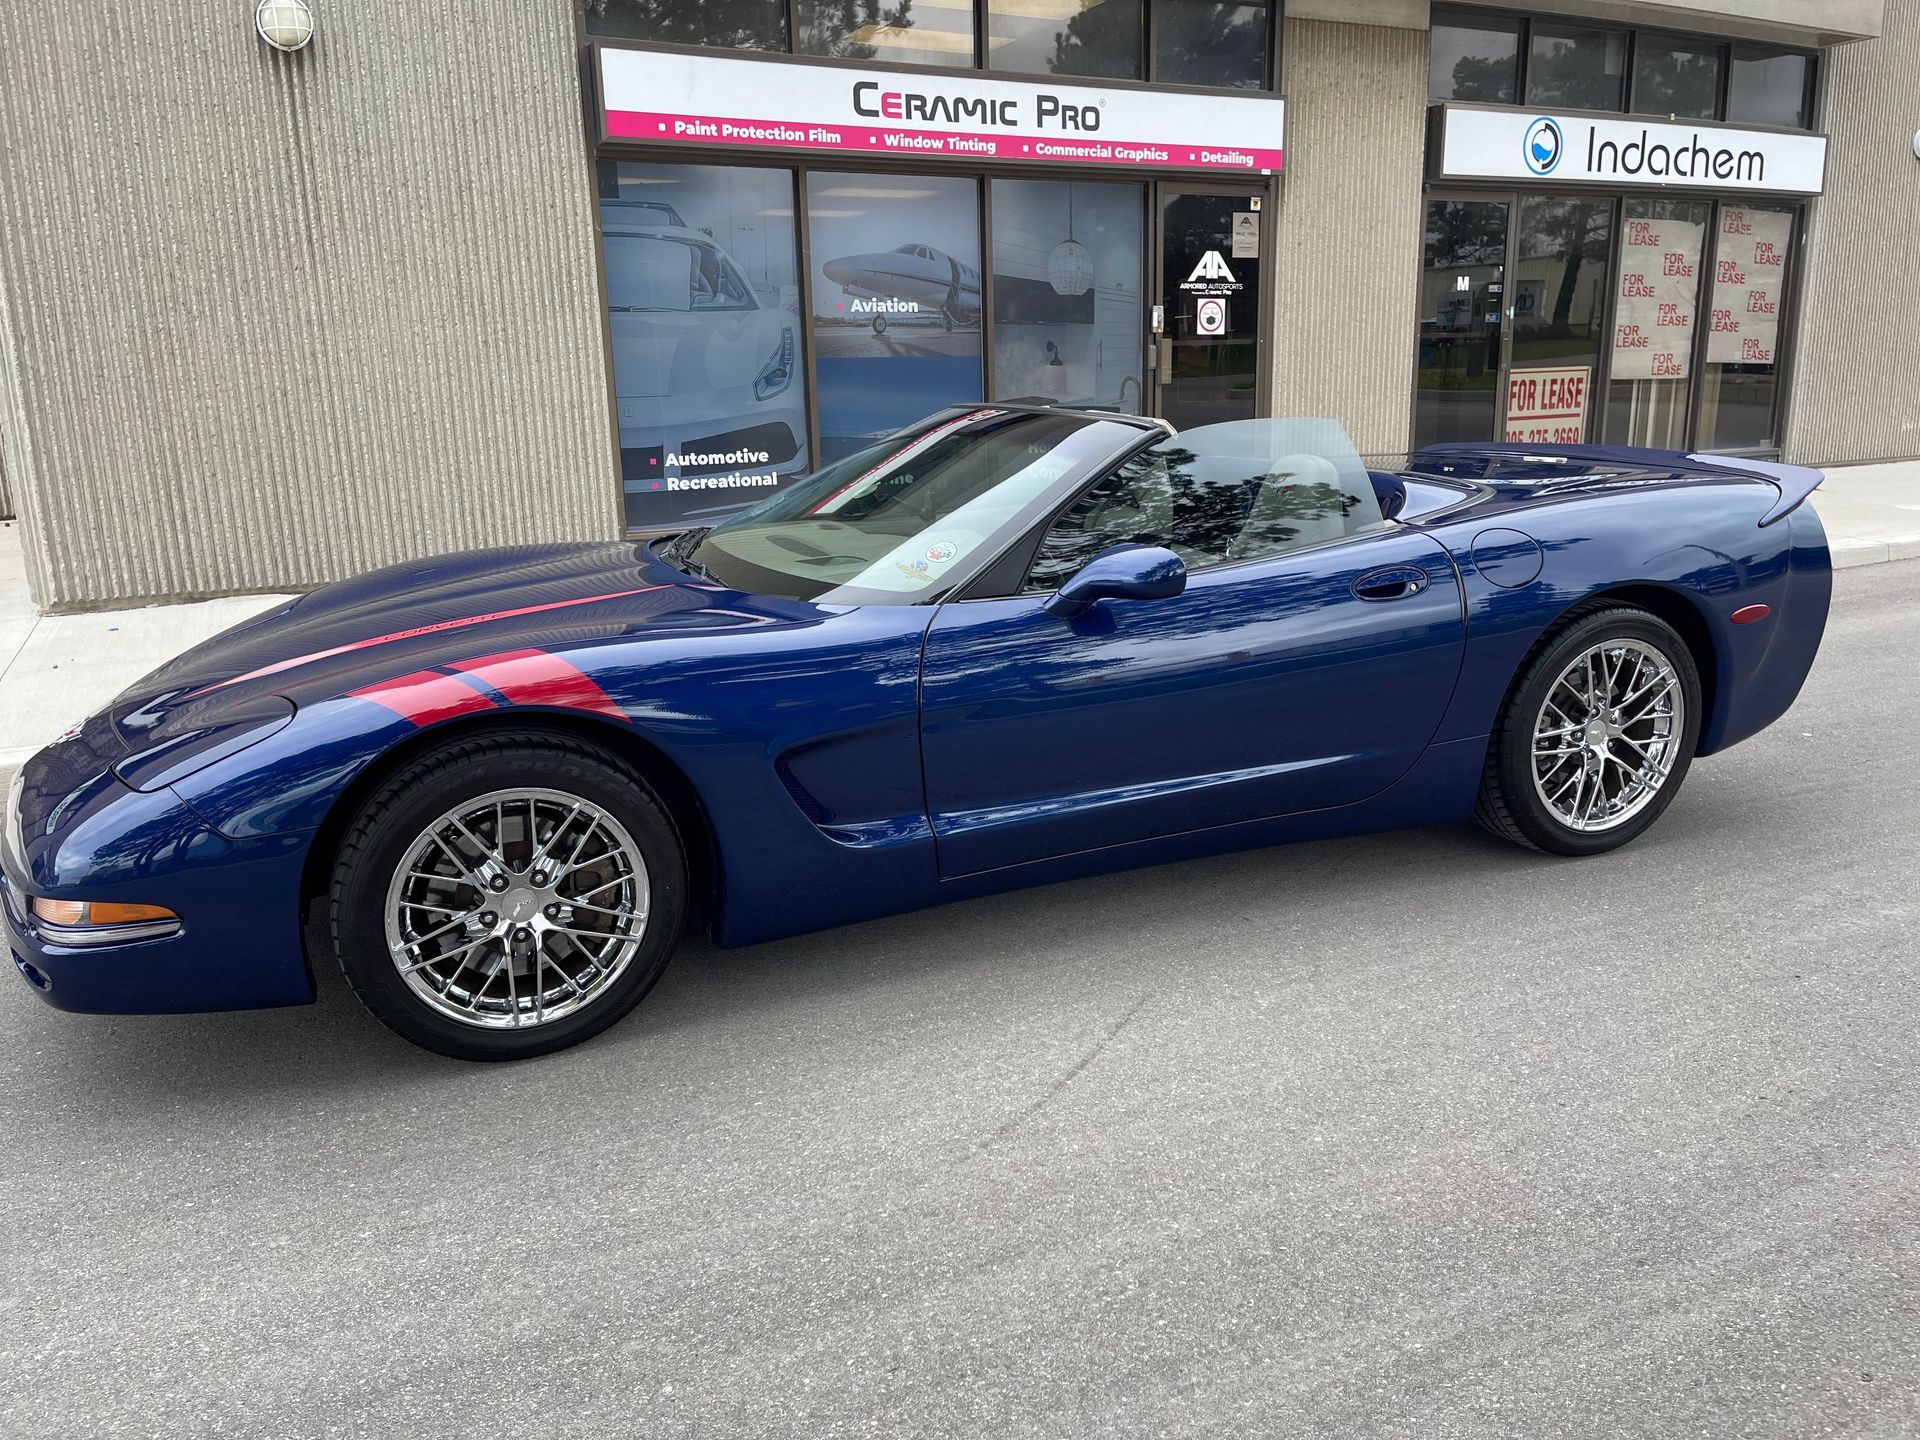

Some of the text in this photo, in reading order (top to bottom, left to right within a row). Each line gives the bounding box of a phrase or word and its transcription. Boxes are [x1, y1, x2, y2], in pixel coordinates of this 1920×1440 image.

[853, 81, 1018, 126] CERAMIC
[674, 120, 842, 144] Paint Protection Film
[884, 133, 997, 155] Window Tinting
[1035, 142, 1169, 163] Commercial Graphics
[1200, 150, 1254, 167] Detailing
[1586, 126, 1765, 182] Indachem
[1724, 210, 1744, 222] FOR
[1629, 221, 1650, 234] FOR
[1723, 222, 1752, 235] LEASE
[1628, 234, 1660, 247] LEASE
[1755, 242, 1774, 254] FOR
[1663, 253, 1684, 265] FOR
[1754, 254, 1782, 266] LEASE
[1663, 265, 1693, 277] LEASE
[1718, 260, 1737, 272] FOR
[1623, 274, 1644, 286] FOR
[1717, 272, 1746, 284] LEASE
[1622, 286, 1655, 298] LEASE
[1748, 290, 1767, 302] FOR
[850, 297, 919, 314] Aviation
[1658, 303, 1678, 315] FOR
[1747, 302, 1775, 314] LEASE
[1657, 315, 1688, 327] LEASE
[1711, 310, 1731, 321] FOR
[1617, 325, 1640, 337] FOR
[1709, 321, 1740, 332] LEASE
[1616, 336, 1649, 348] LEASE
[1742, 339, 1760, 350] FOR
[1652, 353, 1673, 364] FOR
[1742, 350, 1770, 361] LEASE
[1651, 364, 1682, 376] LEASE
[1509, 377, 1584, 412] FOR LEASE
[665, 448, 769, 467] Automotive
[667, 472, 778, 491] Recreational
